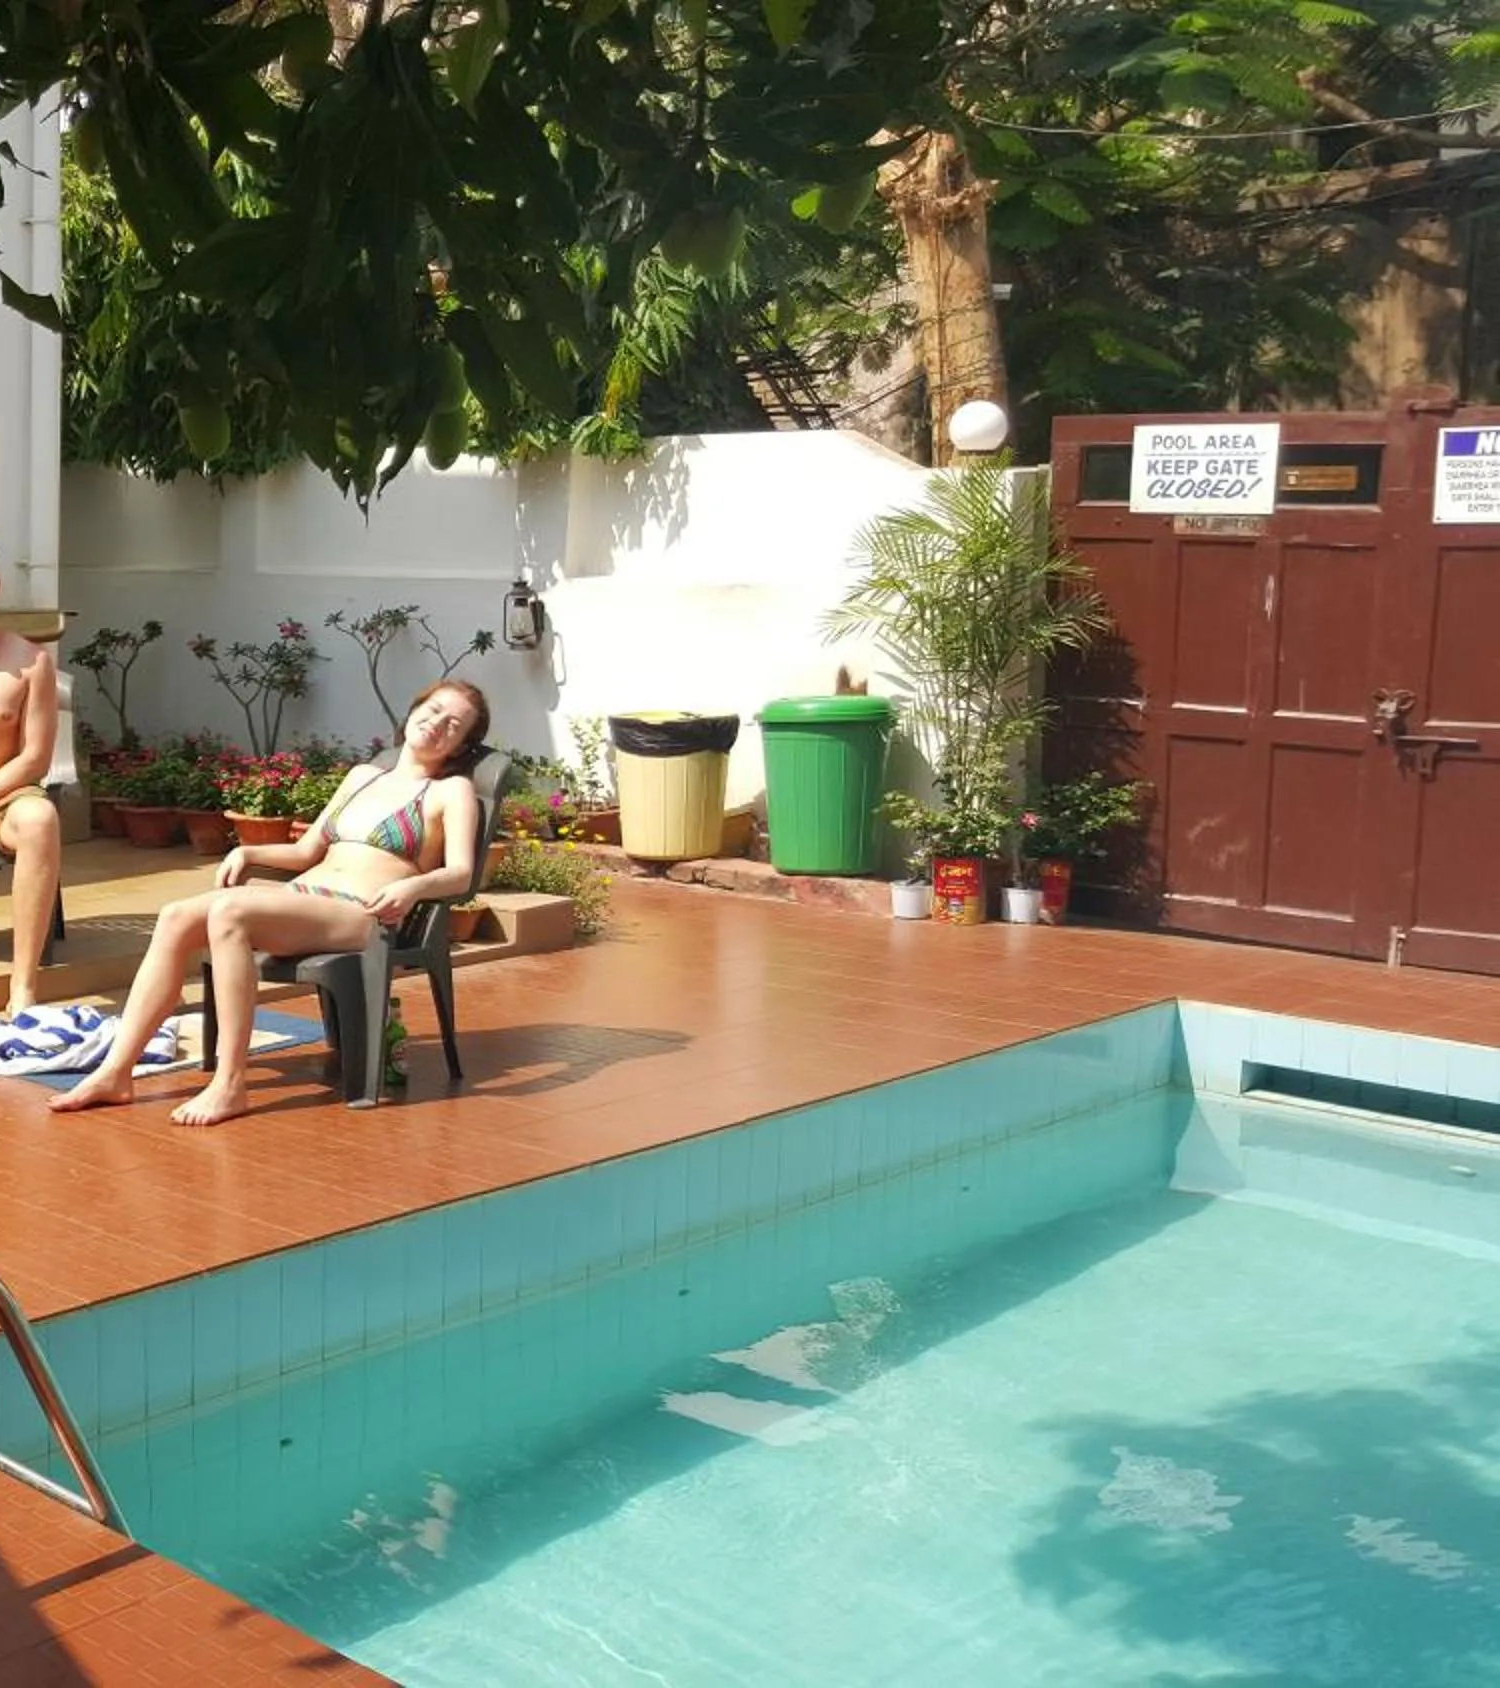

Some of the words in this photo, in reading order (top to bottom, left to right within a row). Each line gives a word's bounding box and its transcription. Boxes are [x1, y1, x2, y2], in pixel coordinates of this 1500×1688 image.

[1151, 435, 1197, 450] POOL
[1203, 434, 1257, 450] AREA
[1475, 431, 1500, 455] N
[1146, 459, 1199, 476] KEEP
[1205, 459, 1259, 476] GATE
[1147, 477, 1263, 499] CLOSED!
[1185, 518, 1205, 529] NO
